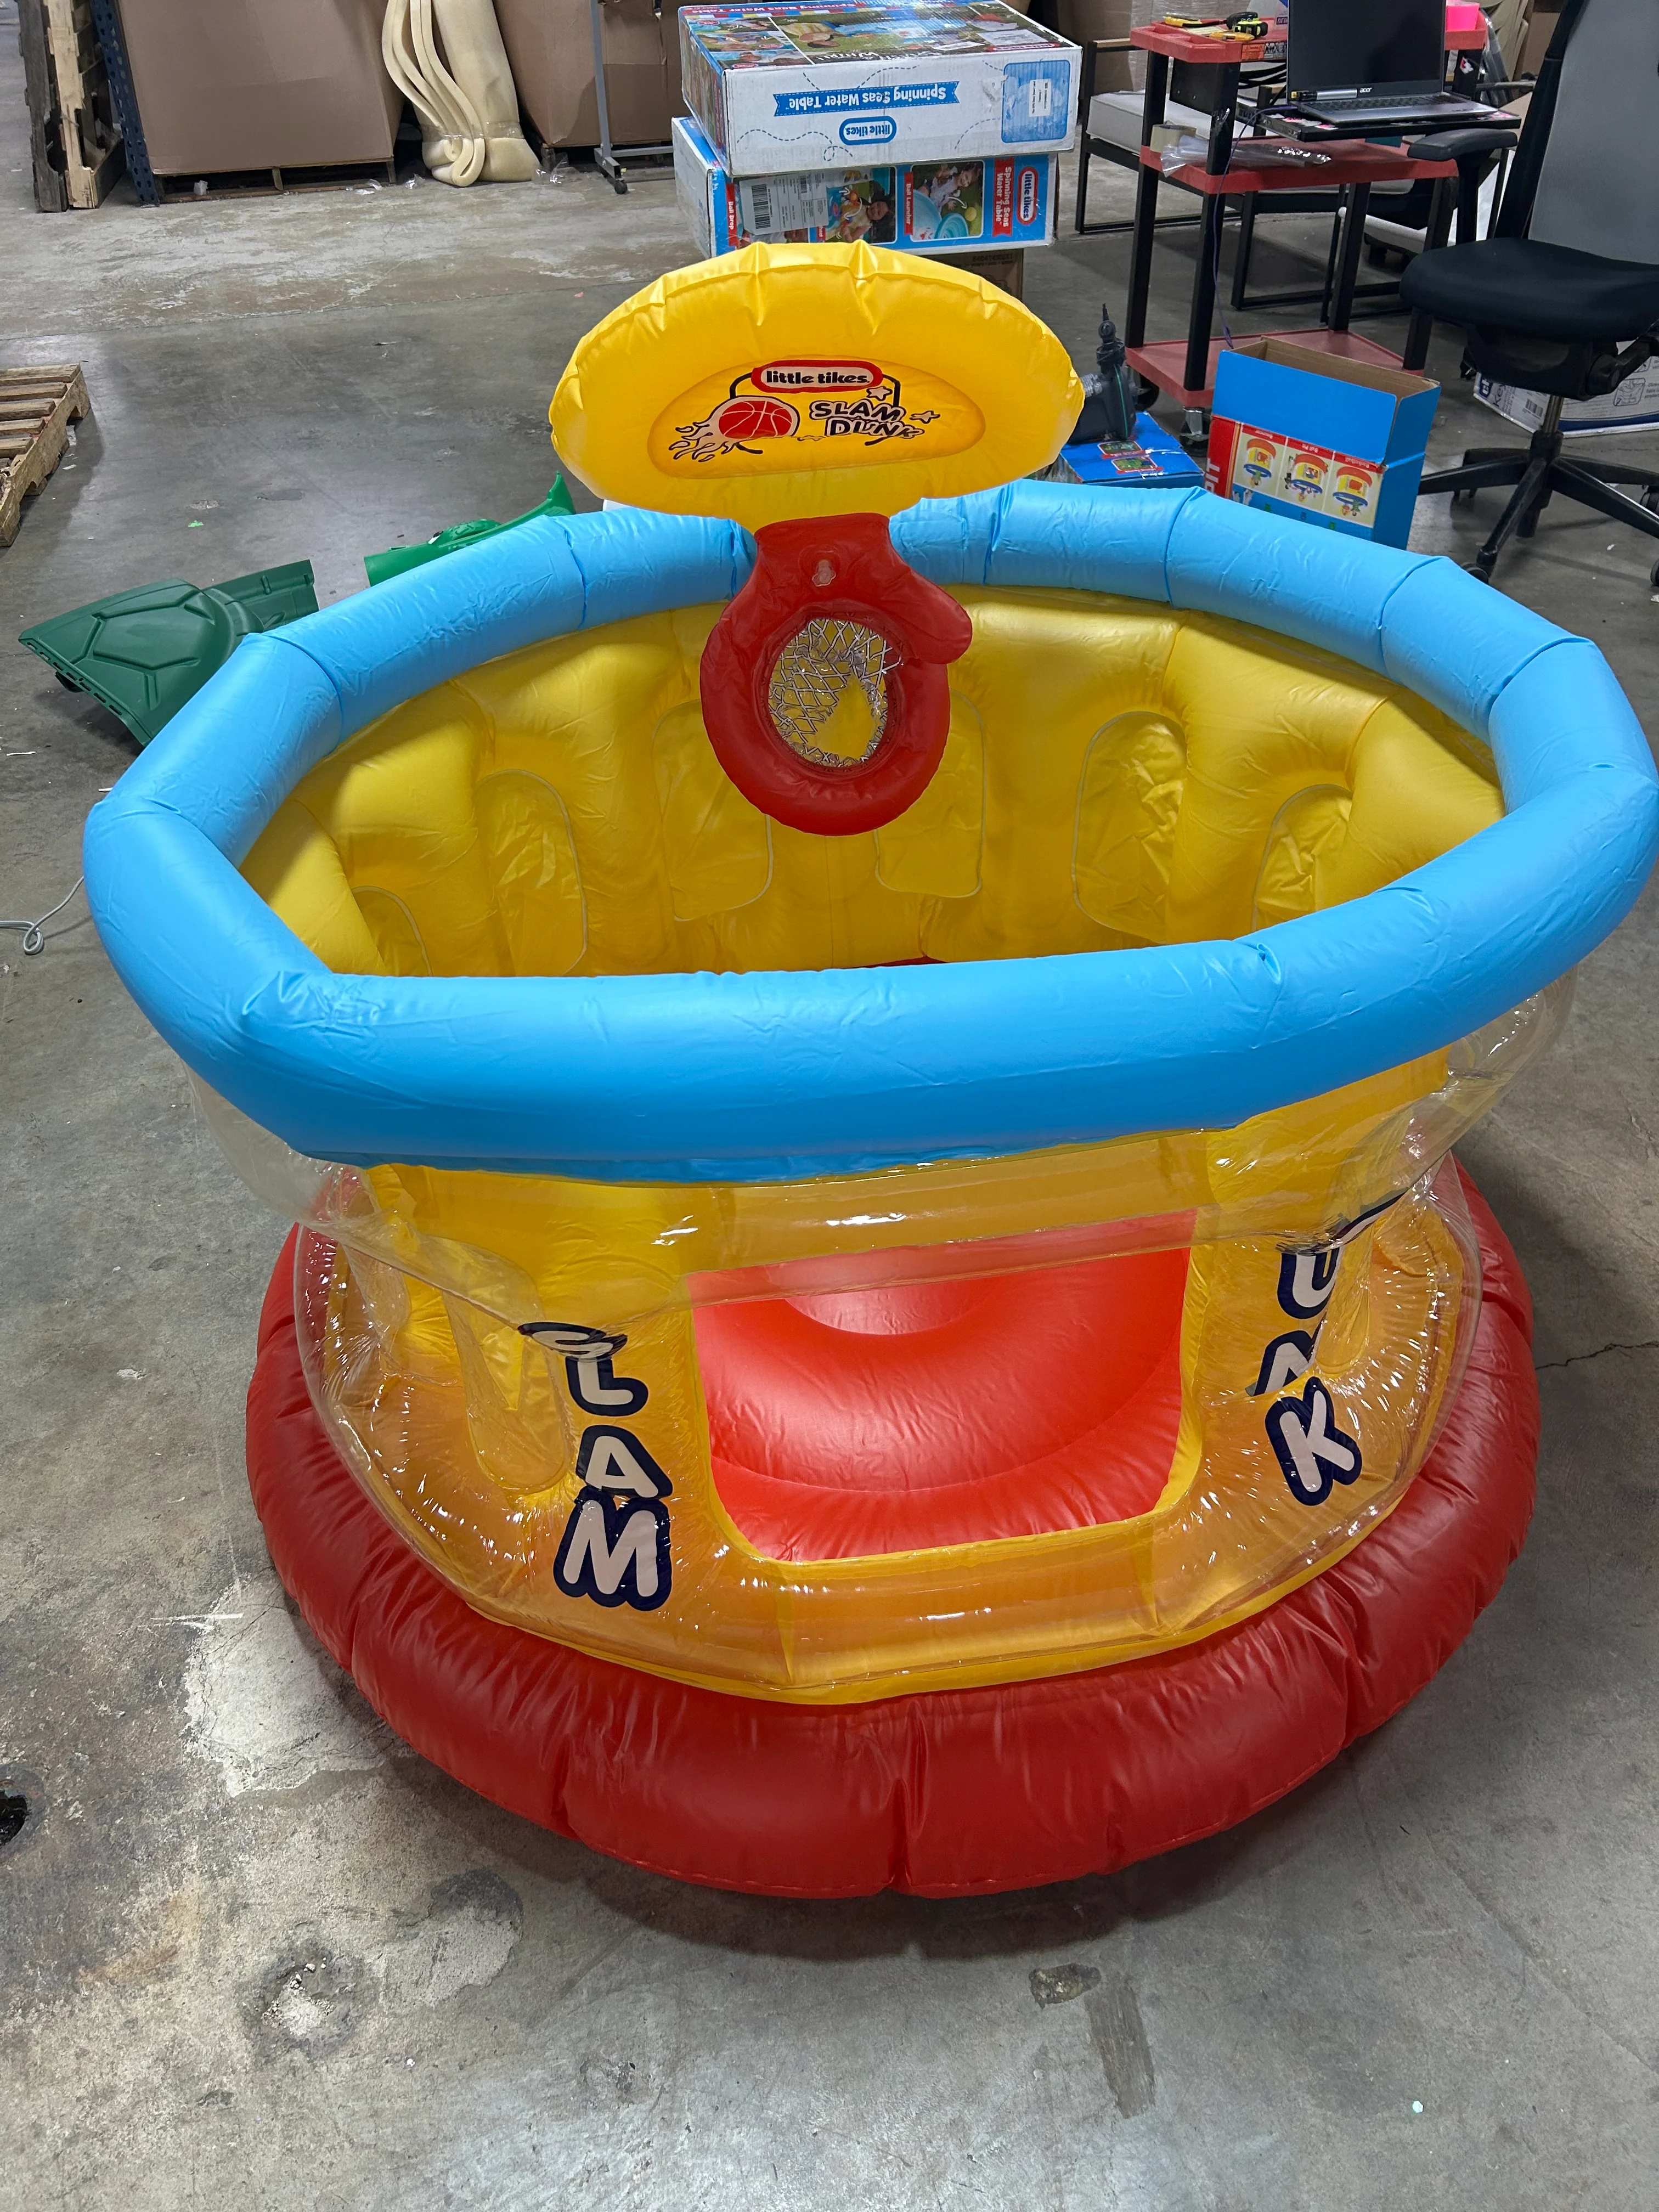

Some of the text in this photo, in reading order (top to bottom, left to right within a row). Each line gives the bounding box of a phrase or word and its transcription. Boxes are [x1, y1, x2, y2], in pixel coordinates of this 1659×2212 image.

[789, 84, 946, 110] Spinning Seas Water Table
[845, 125, 890, 137] little tikes
[1003, 166, 1012, 205] Spinning
[1023, 173, 1032, 219] little tikes
[766, 370, 868, 384] little tikes
[811, 399, 905, 421] SLAM
